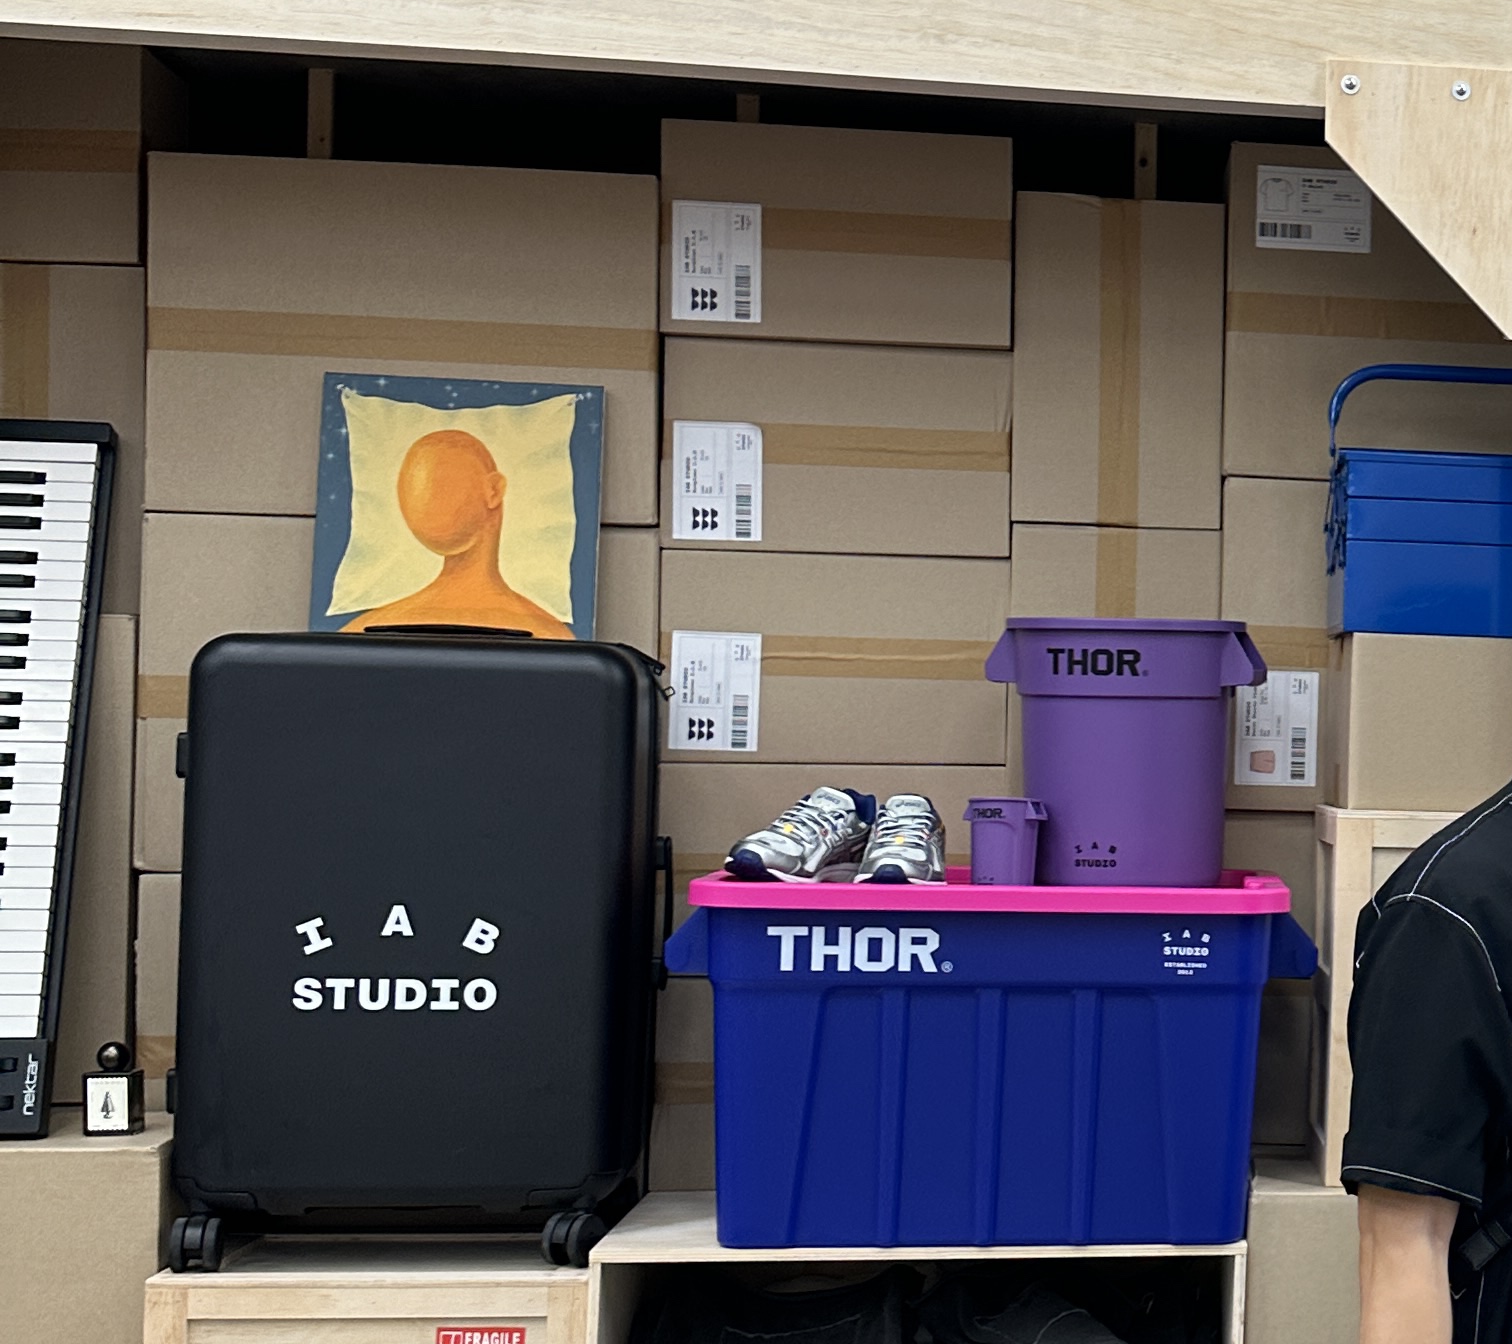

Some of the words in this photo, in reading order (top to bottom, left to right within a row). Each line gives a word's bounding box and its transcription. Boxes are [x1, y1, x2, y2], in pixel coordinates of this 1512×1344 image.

[1074, 858, 1117, 868] STUDIO
[1163, 946, 1210, 957] STUDIO
[292, 976, 498, 1011] STUDIO
[22, 1052, 39, 1117] nektar
